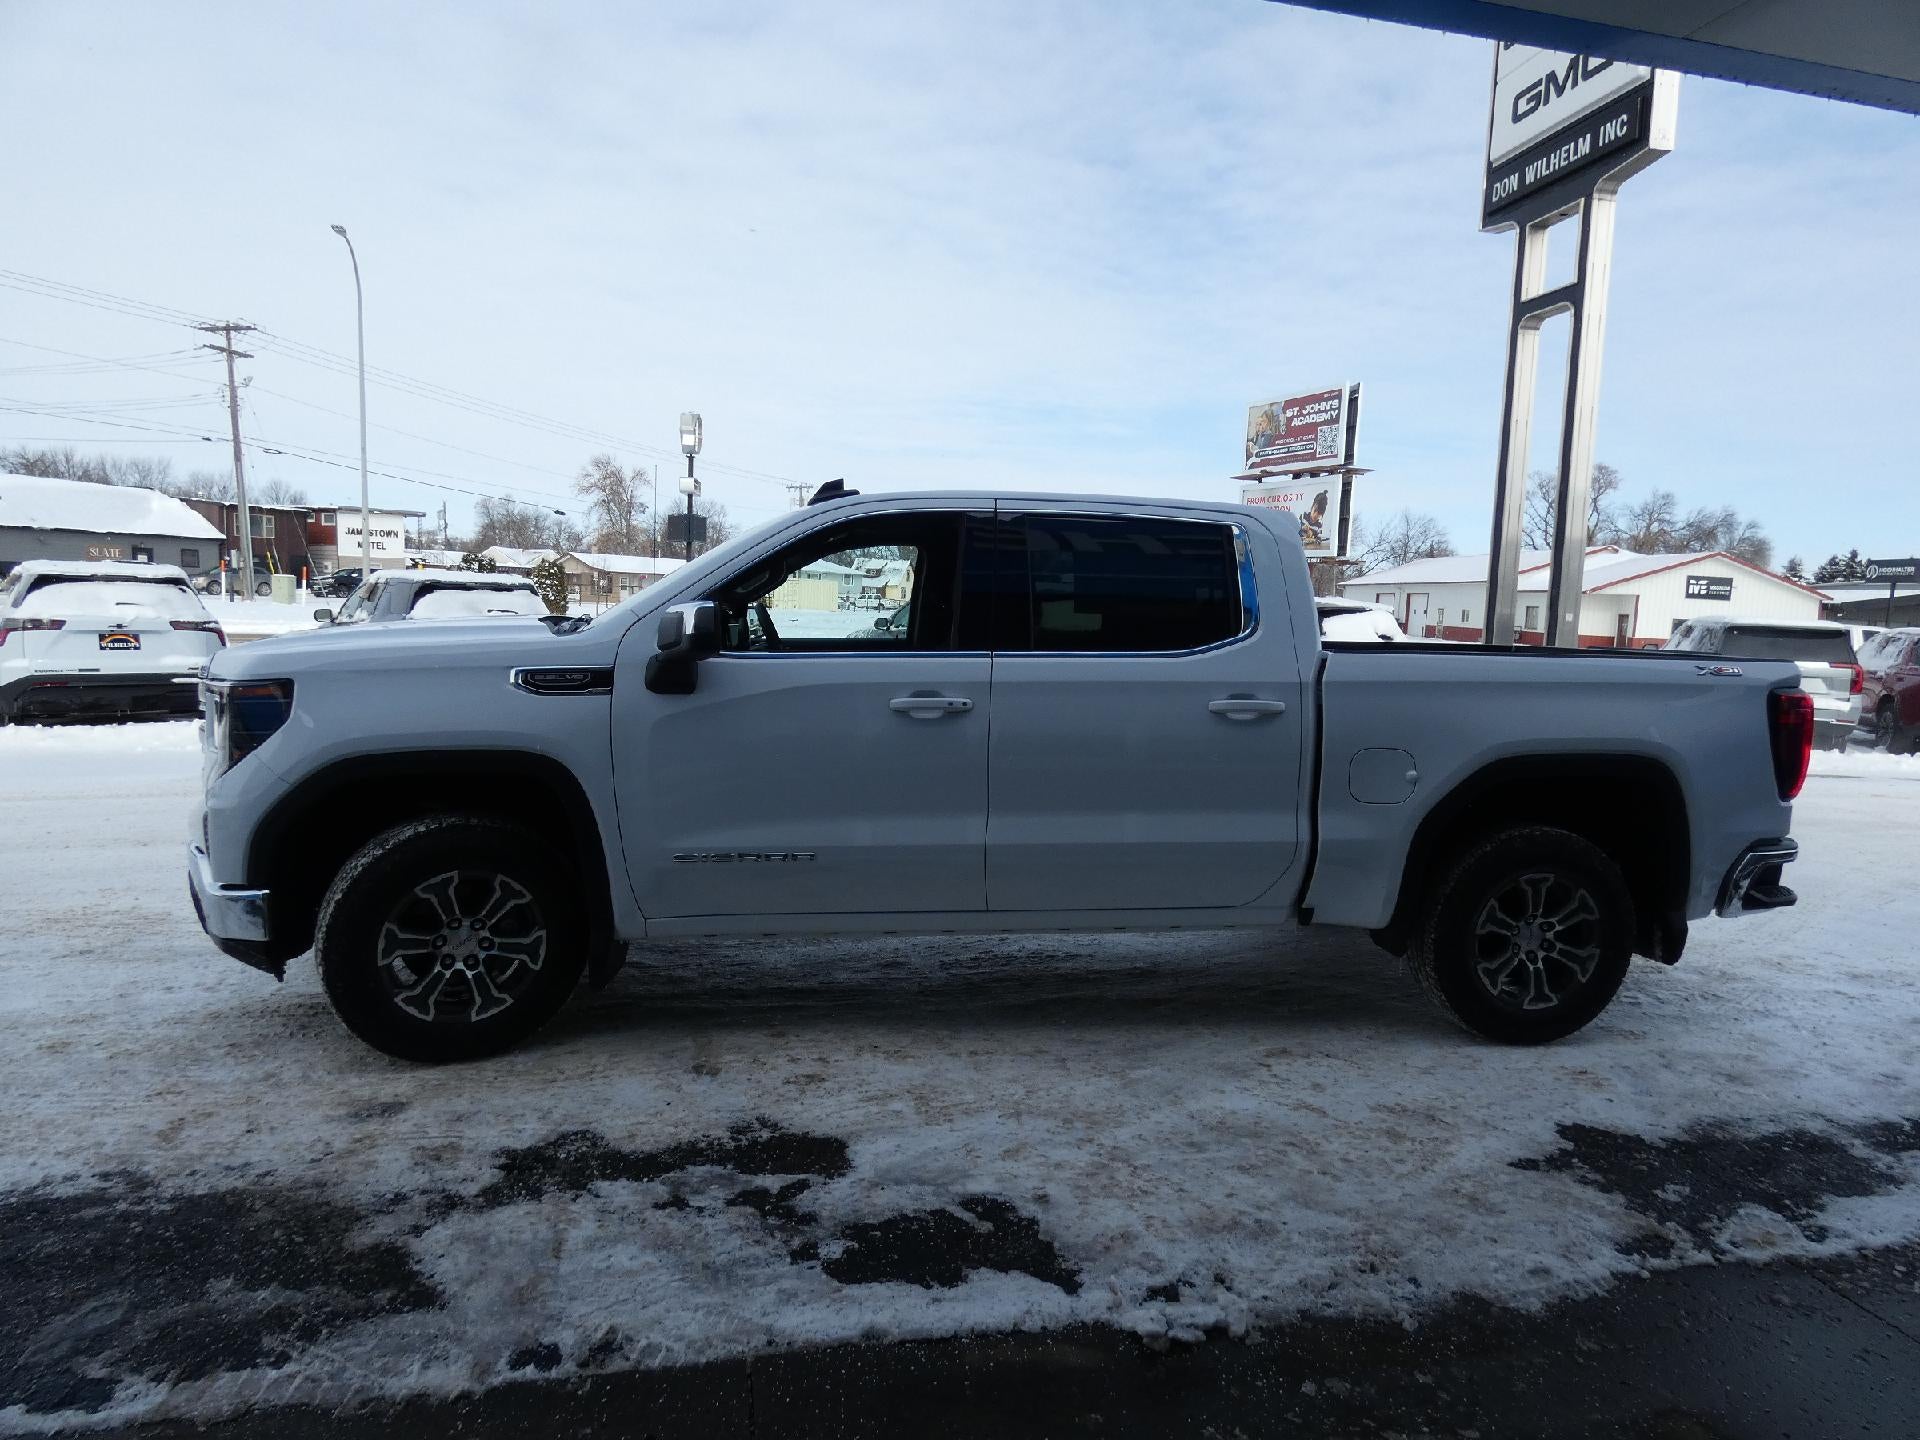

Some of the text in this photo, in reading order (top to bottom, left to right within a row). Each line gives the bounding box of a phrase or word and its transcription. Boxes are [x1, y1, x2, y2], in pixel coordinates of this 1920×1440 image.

[1492, 114, 1628, 203] DON WILHELM INC
[1286, 399, 1339, 417] ST. JOHN'S
[1291, 410, 1339, 427] ACADEMY
[1247, 496, 1266, 505] FROM
[345, 527, 399, 539] JAMSTOWN
[357, 541, 386, 550] MTEL
[89, 547, 122, 558] SLATE
